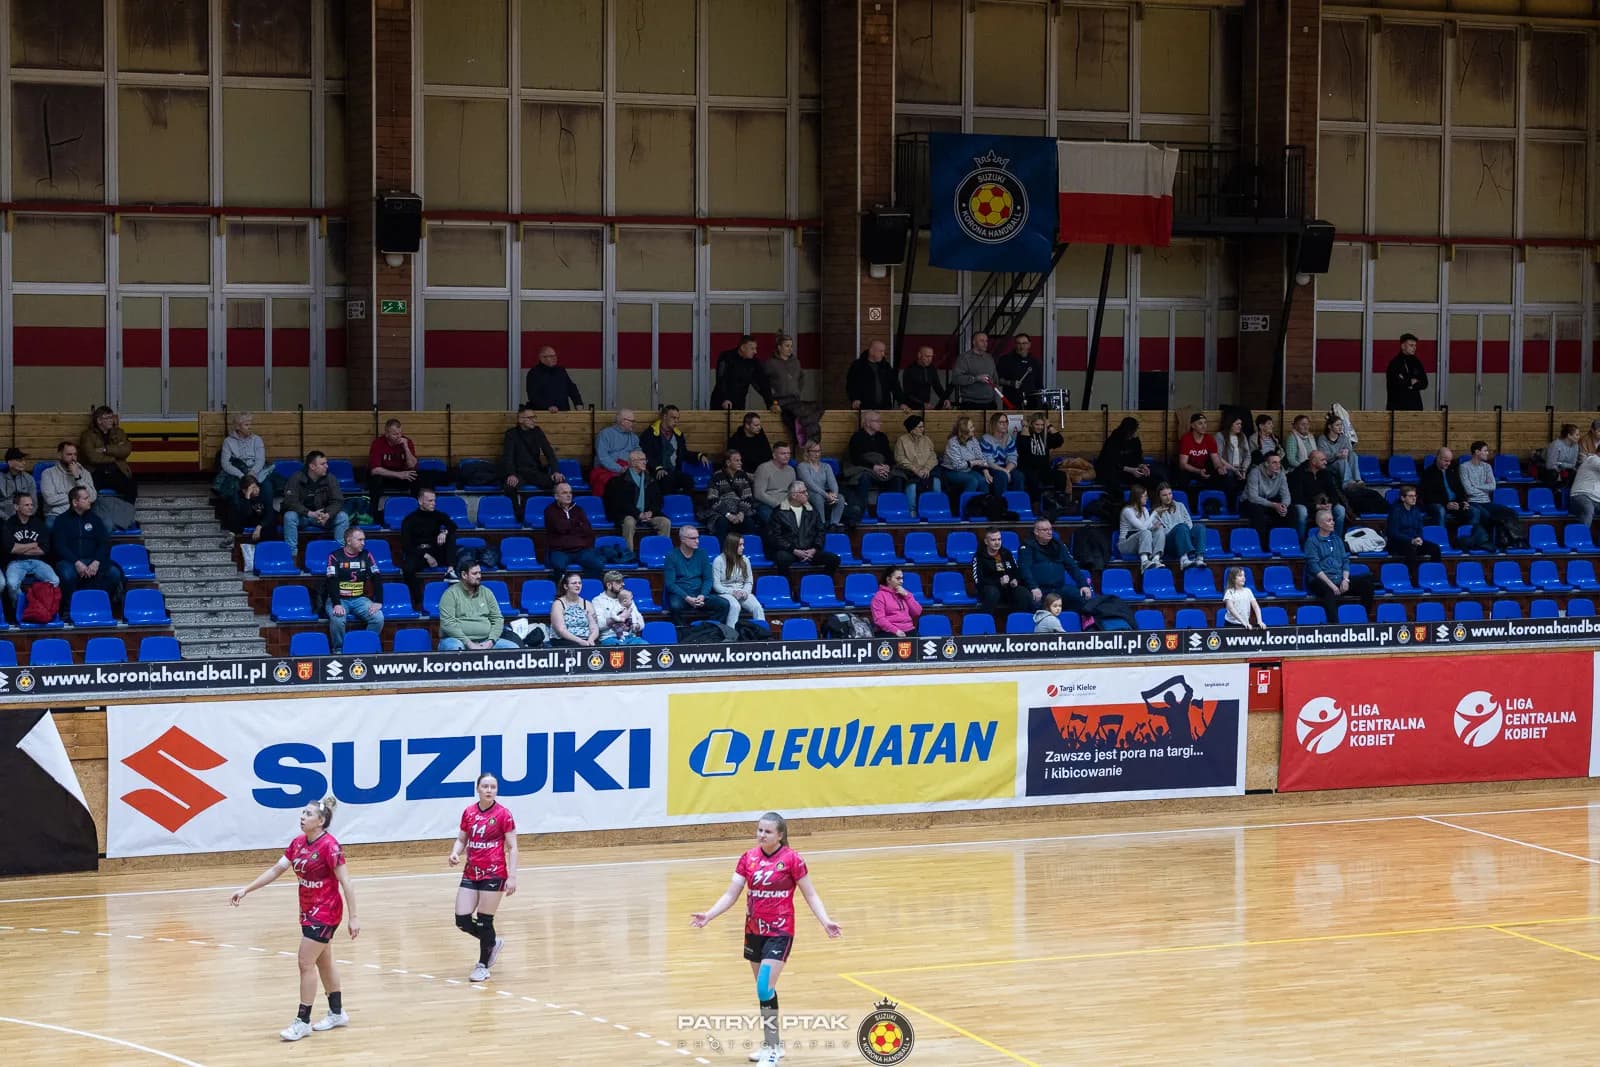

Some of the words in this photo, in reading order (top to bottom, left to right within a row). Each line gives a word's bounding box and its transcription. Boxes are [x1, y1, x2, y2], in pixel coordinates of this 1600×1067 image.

[977, 173, 1006, 183] SUZUKI
[961, 210, 987, 236] KORONA
[988, 212, 1022, 237] HANDBALL
[350, 571, 358, 582] 5
[1226, 627, 1393, 646] www.koronahandball.pl
[963, 635, 1141, 654] www.koronahandball.pl
[679, 643, 872, 664] www.koronahandball.pl
[373, 652, 582, 674] www.koronahandball.pl
[42, 663, 267, 686] www.koronahandball.pl
[1059, 684, 1075, 693] Targi
[1076, 683, 1097, 691] Kielce
[1350, 704, 1380, 716] LIGA
[1505, 697, 1534, 710] LIGA
[1350, 717, 1426, 732] CENTRALNA
[1504, 711, 1577, 725] CENTRALNA
[1349, 733, 1395, 747] KOBIET
[1504, 727, 1548, 740] KOBIET
[753, 718, 999, 772] LEWIATAN
[1045, 750, 1092, 763] Zawsze
[1094, 748, 1117, 763] jest
[1120, 749, 1146, 761] pora
[1149, 747, 1164, 758] na
[1166, 744, 1204, 759] targi...
[251, 727, 652, 809] SUZUKI
[1045, 768, 1049, 779] i
[1051, 765, 1123, 779] kibicowanie
[471, 823, 487, 838] 14
[753, 869, 774, 886] 32
[752, 889, 789, 898] SUZUKI
